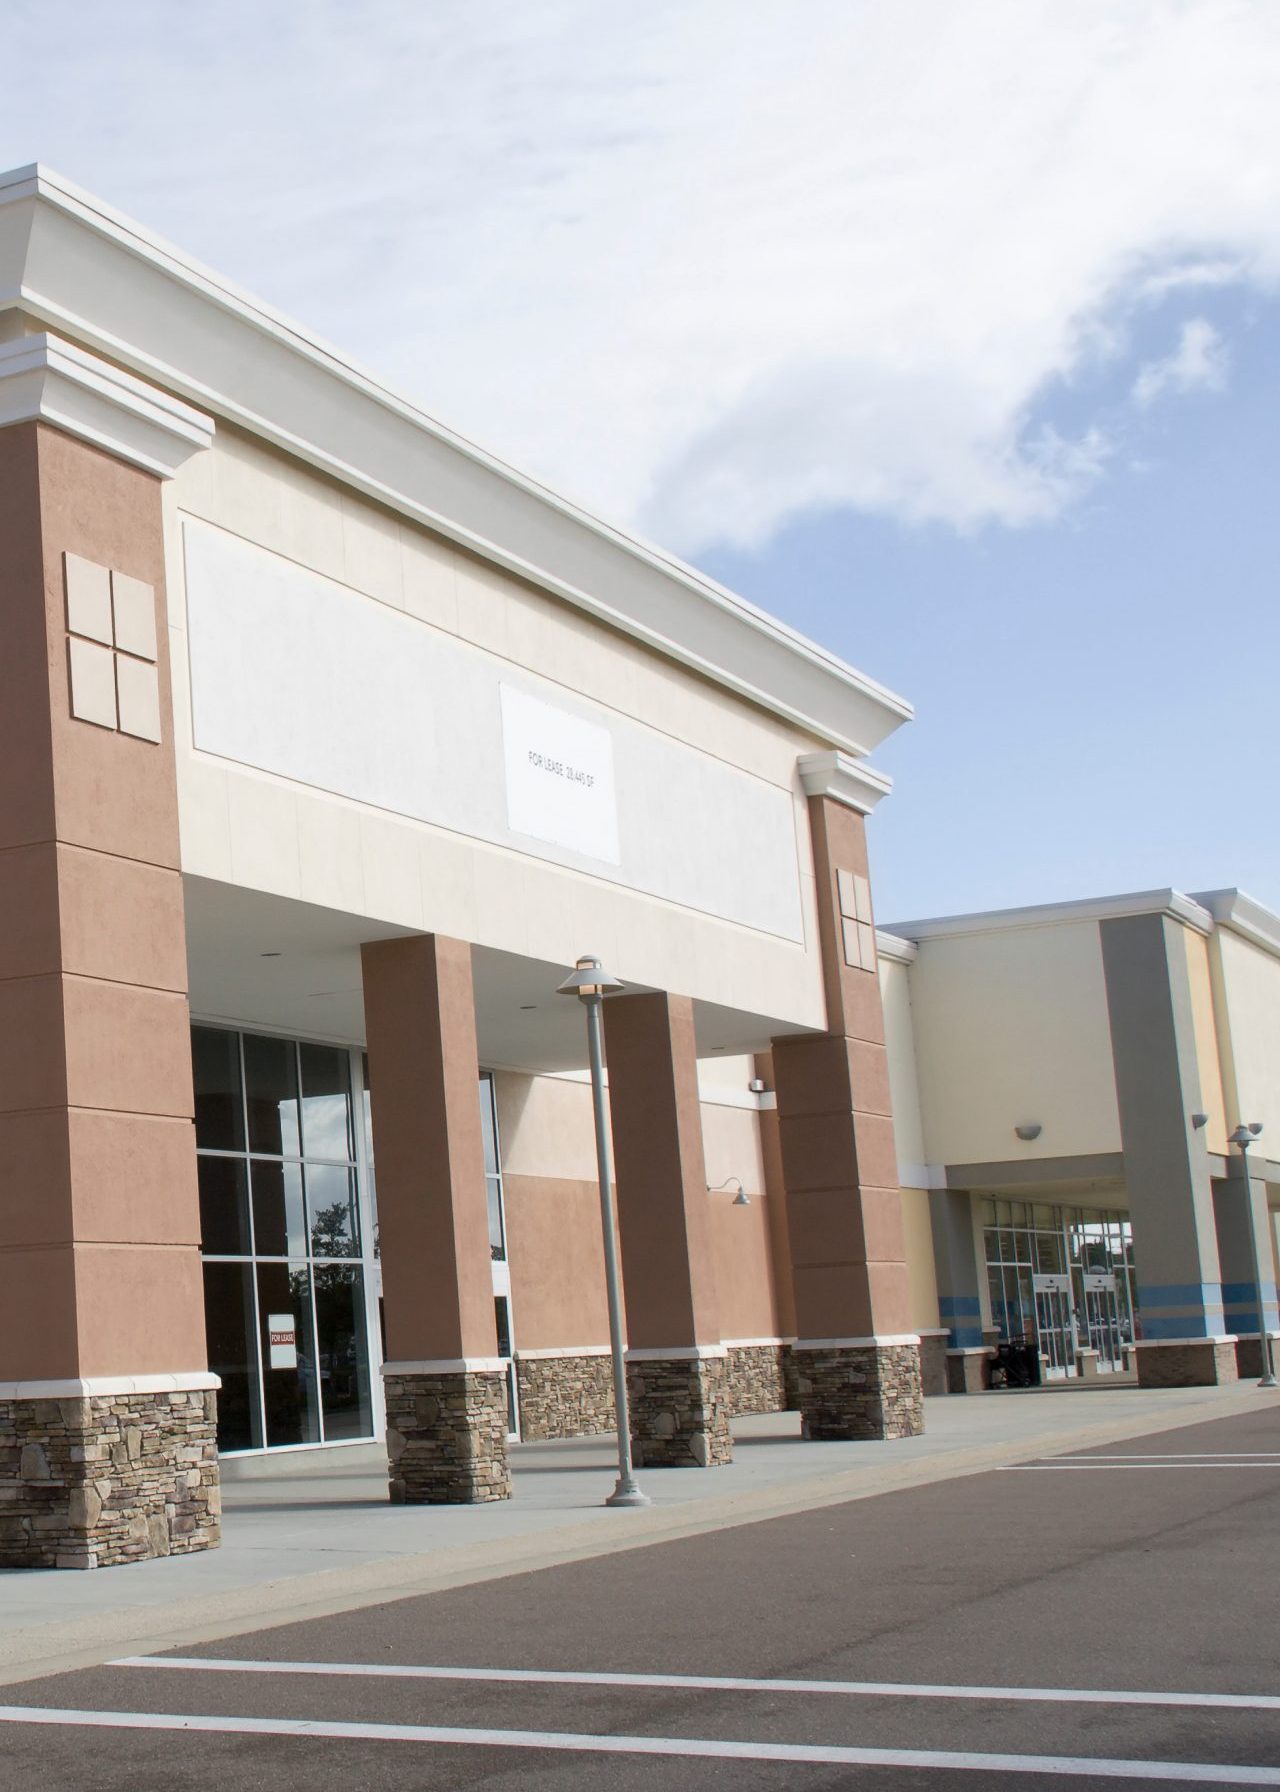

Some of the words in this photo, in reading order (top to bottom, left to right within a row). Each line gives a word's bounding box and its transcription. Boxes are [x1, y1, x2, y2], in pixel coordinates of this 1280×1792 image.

[528, 751, 543, 768] FOR
[544, 757, 563, 776] LEASE
[272, 1334, 280, 1342] FOR
